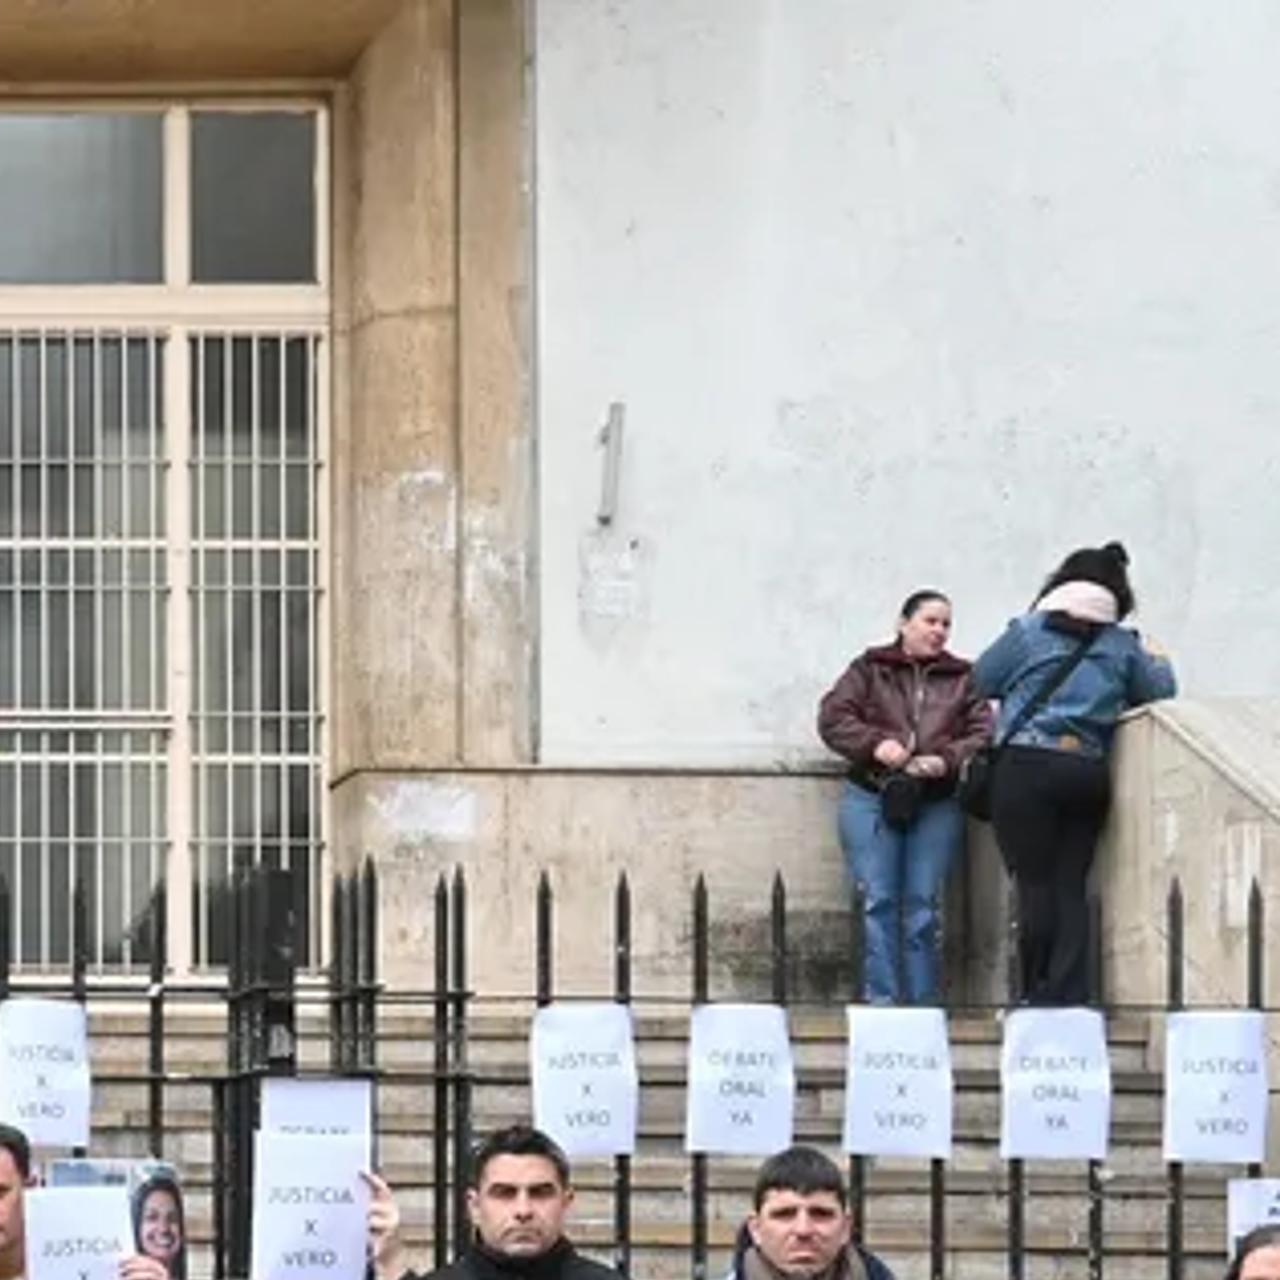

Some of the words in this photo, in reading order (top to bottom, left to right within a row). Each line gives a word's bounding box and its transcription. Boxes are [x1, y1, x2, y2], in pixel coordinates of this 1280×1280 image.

[548, 1053, 620, 1069] JUSTICIA
[708, 1052, 774, 1067] DEBATE
[864, 1052, 937, 1070] JUSTICIA
[1019, 1056, 1089, 1072] DEBATE
[1182, 1059, 1258, 1075] JUSTICIA
[720, 1080, 765, 1096] ORAL
[1032, 1086, 1080, 1101] ORAL
[19, 1104, 65, 1119] VERO
[565, 1110, 610, 1127] VERO
[731, 1113, 752, 1125] YA
[876, 1113, 926, 1128] VERO
[1046, 1115, 1068, 1129] YA
[1195, 1119, 1248, 1135] VERO
[269, 1187, 354, 1204] JUSTICIA
[42, 1238, 121, 1258] JUSTICIA
[283, 1252, 337, 1267] VERO
